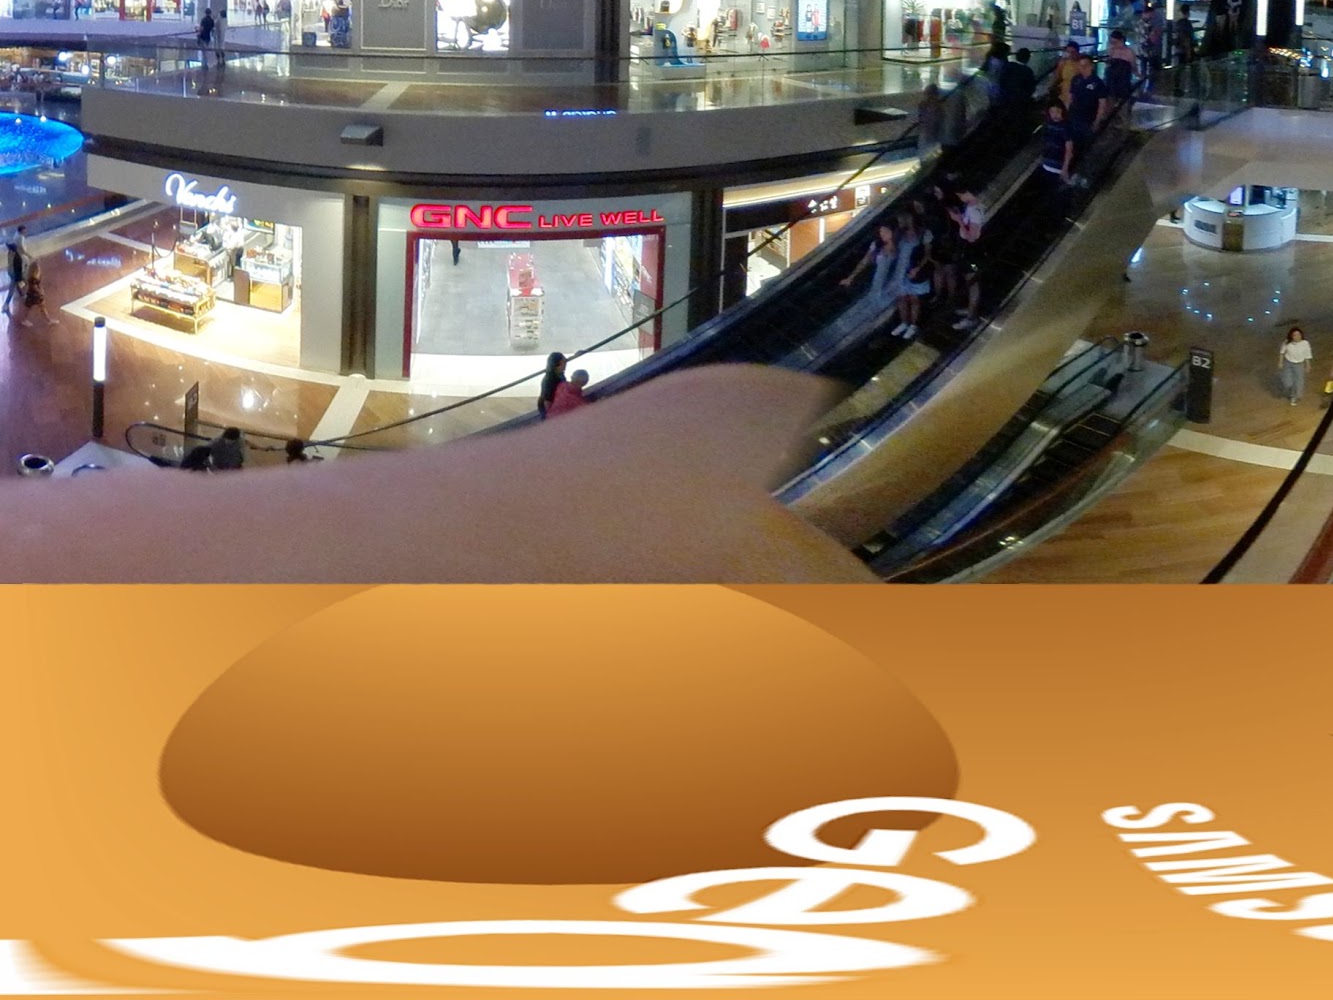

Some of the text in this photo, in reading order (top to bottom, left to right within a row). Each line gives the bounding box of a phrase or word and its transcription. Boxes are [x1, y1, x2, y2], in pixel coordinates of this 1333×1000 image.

[410, 203, 664, 229] GNC LIVE WELL
[1192, 355, 1211, 369] B2
